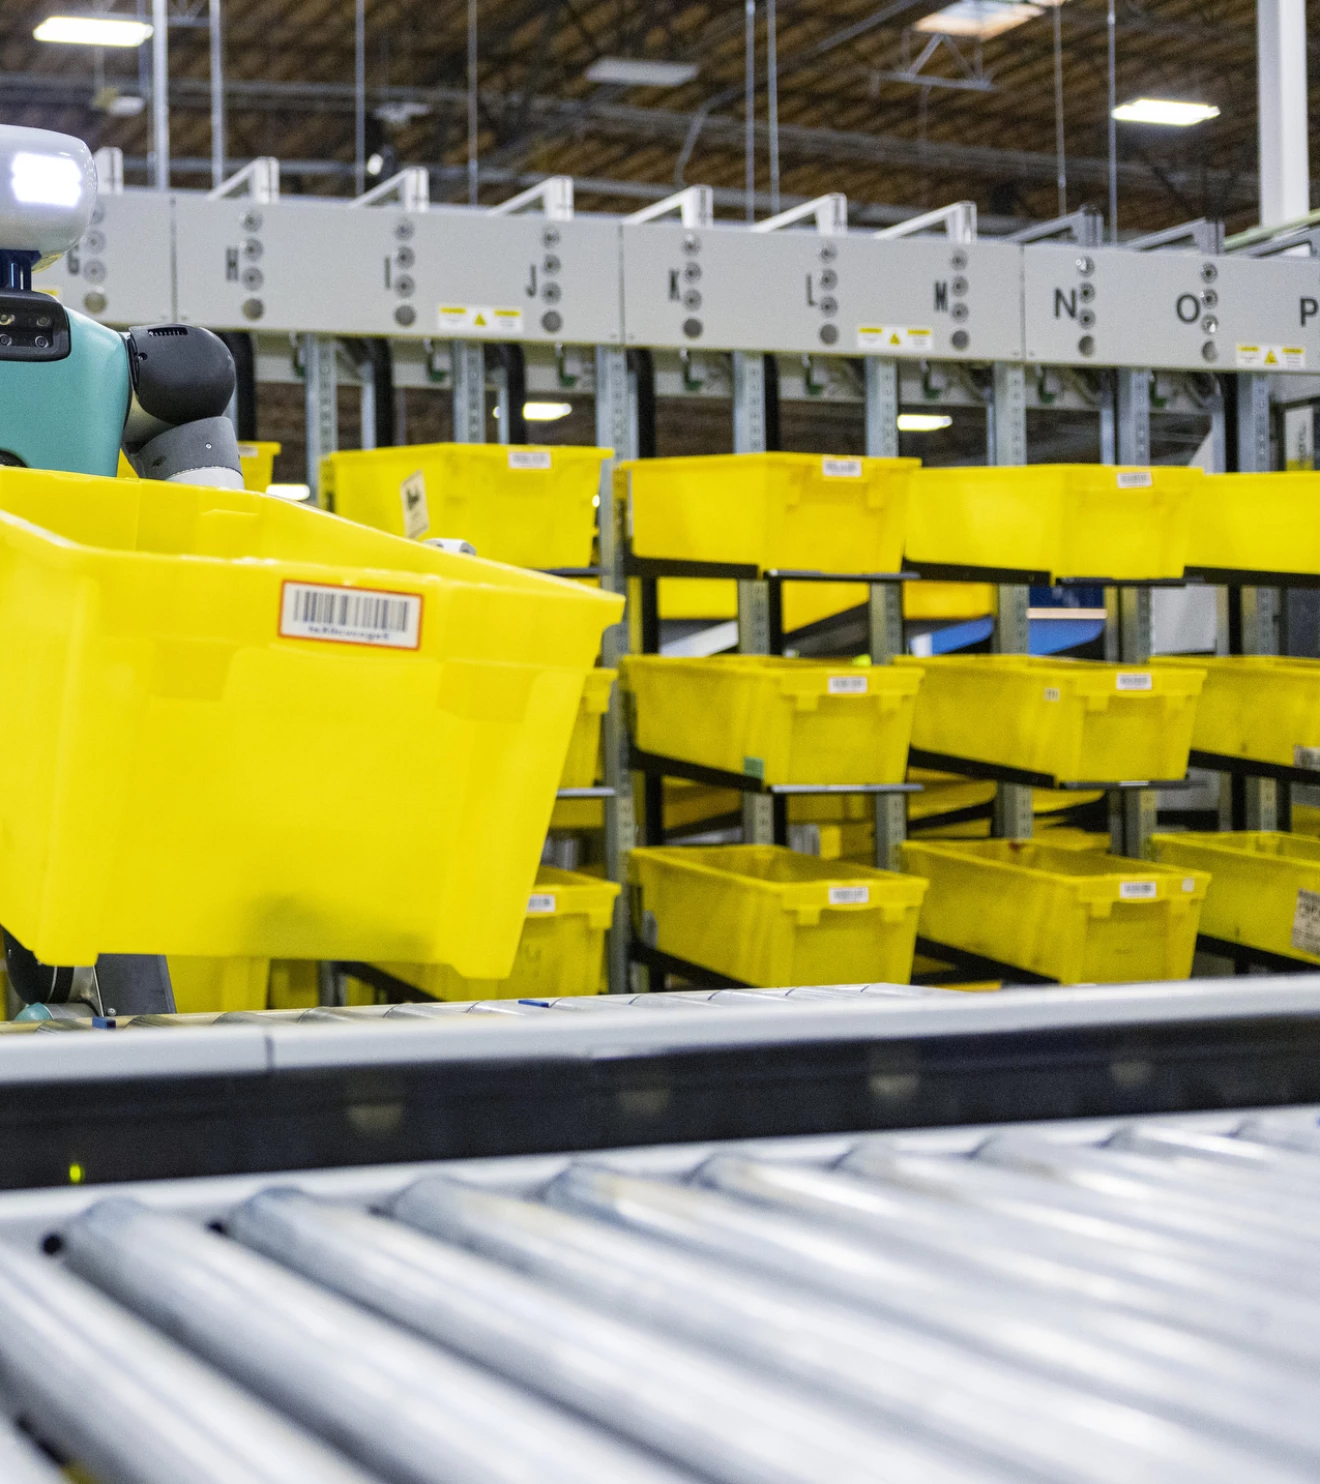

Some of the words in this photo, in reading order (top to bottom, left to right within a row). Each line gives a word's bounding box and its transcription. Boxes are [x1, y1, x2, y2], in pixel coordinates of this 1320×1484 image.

[226, 248, 239, 281] H
[525, 264, 538, 298] J
[669, 270, 682, 301] K
[805, 273, 818, 307] L
[933, 281, 947, 312] M
[1055, 289, 1079, 319] N
[1175, 295, 1200, 324] O
[1299, 299, 1320, 327] P
